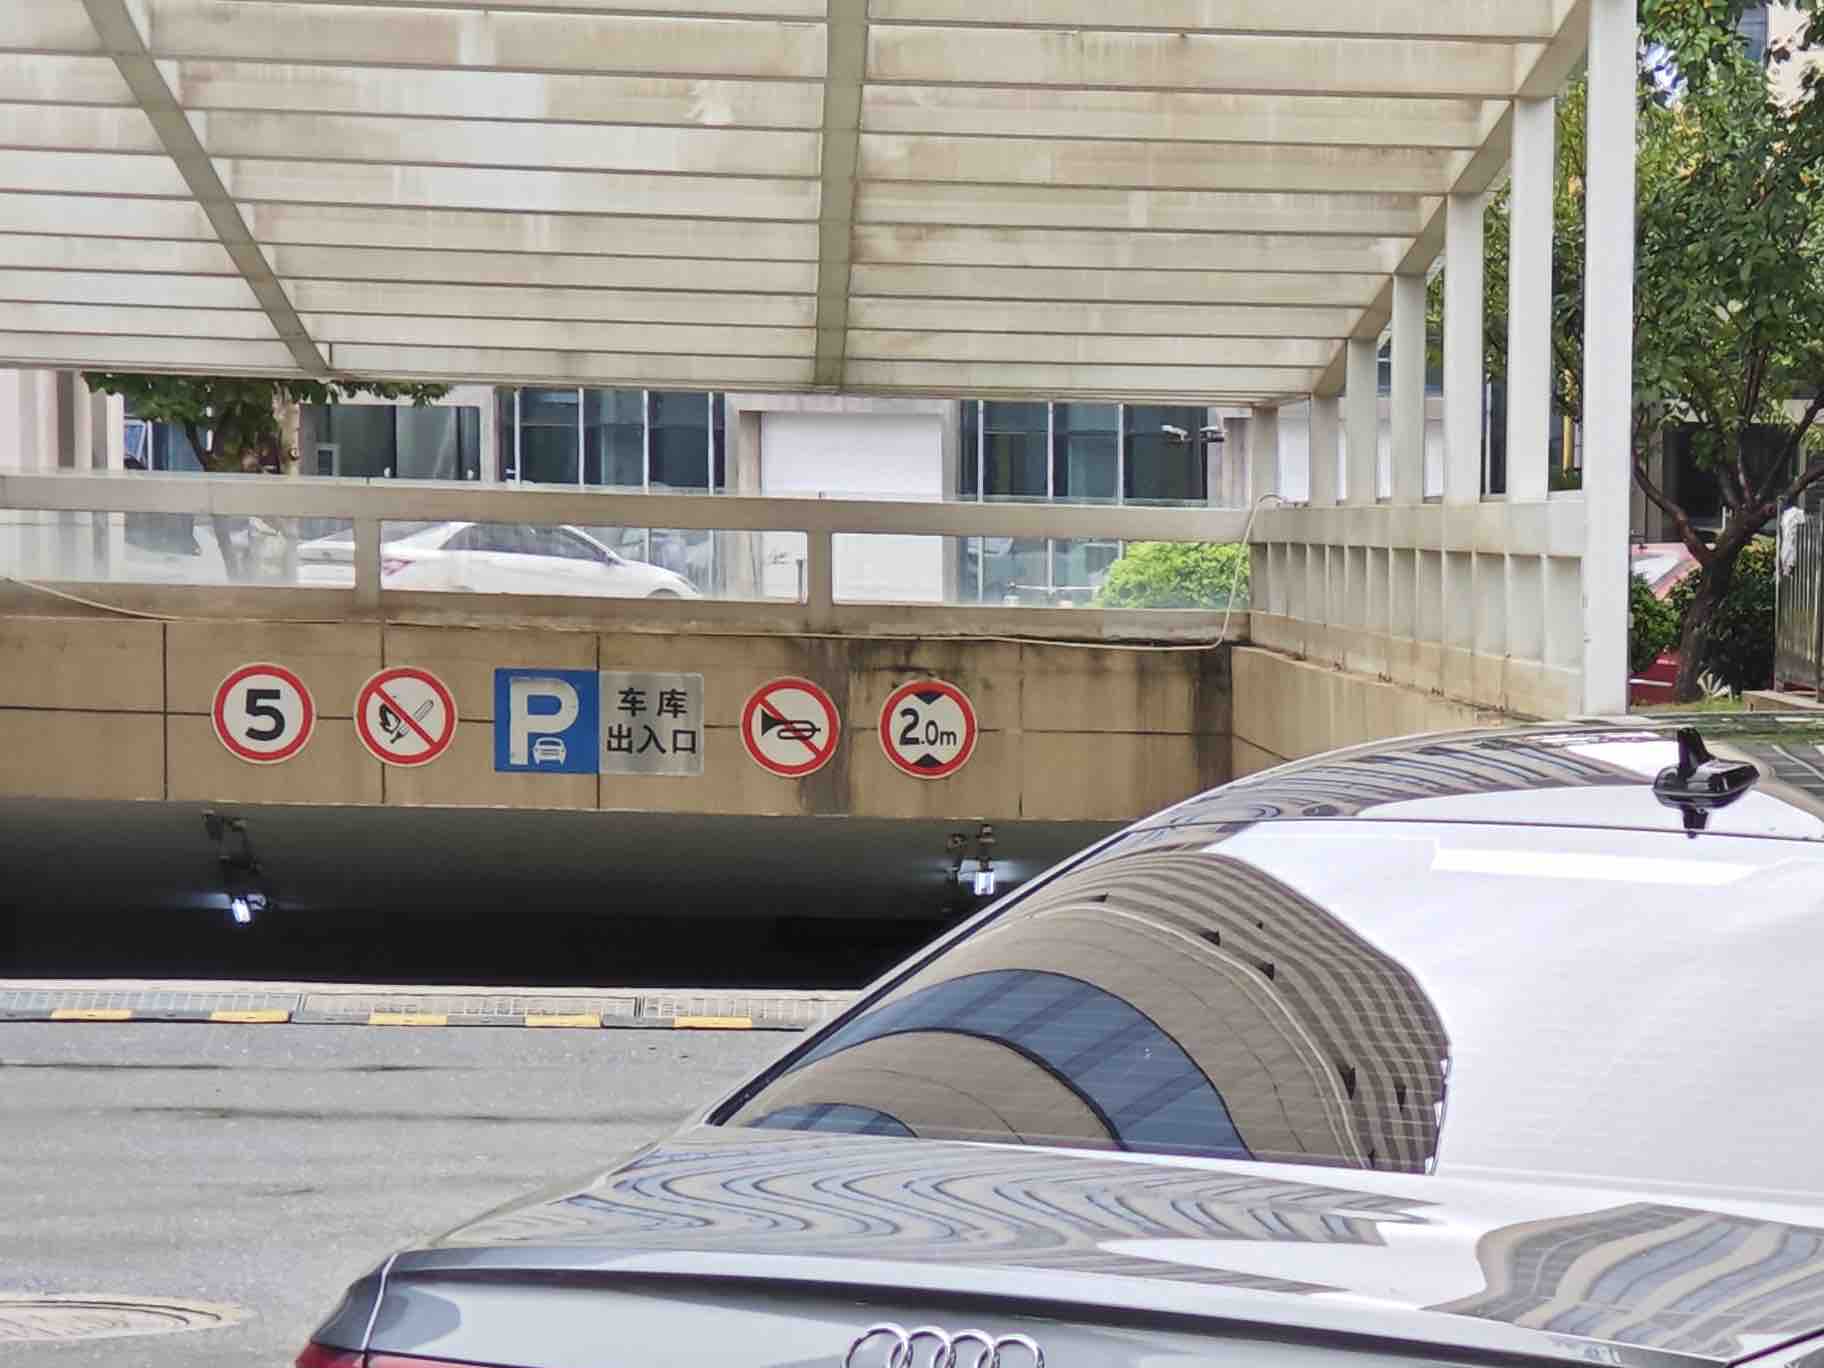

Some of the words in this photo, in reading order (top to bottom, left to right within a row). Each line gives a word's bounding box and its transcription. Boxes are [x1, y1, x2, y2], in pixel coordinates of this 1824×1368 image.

[245, 688, 286, 742] 5
[509, 676, 580, 766] P
[617, 687, 688, 719] 车库
[605, 723, 697, 755] 出入口
[898, 707, 958, 747] 2.0m
